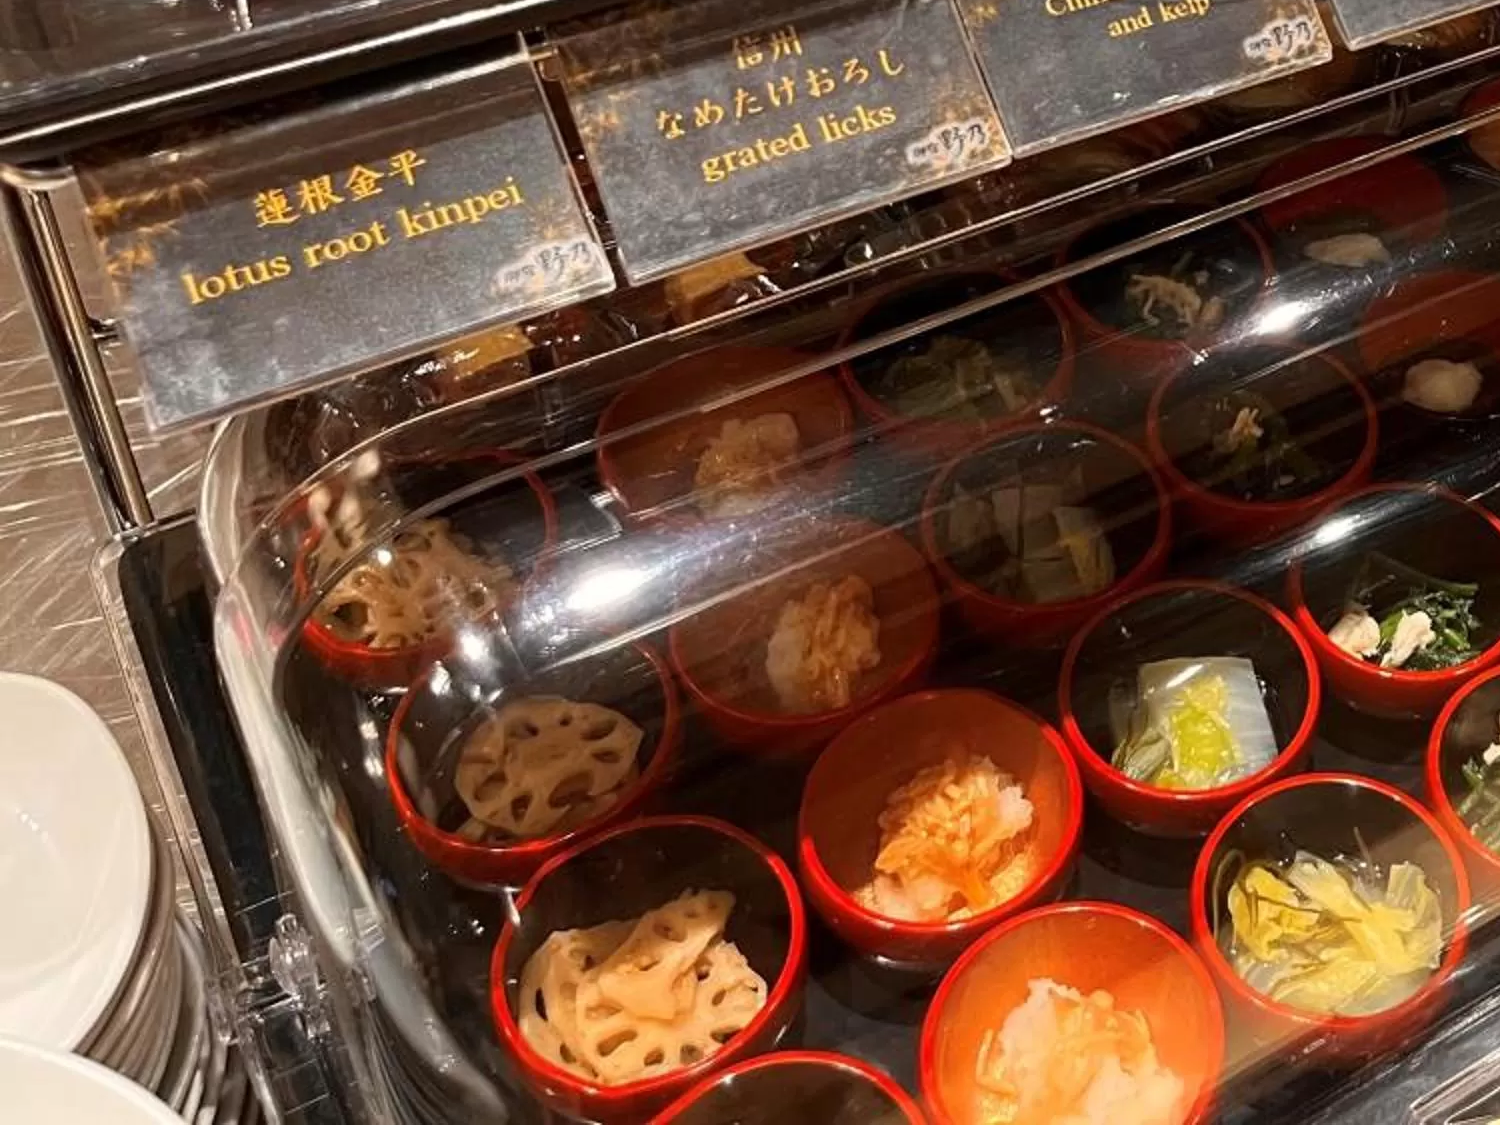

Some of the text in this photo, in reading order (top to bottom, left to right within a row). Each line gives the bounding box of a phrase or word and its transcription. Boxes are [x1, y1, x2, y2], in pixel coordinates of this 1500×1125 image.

[1107, 5, 1153, 38] and
[656, 49, 905, 140] なめたけおろし
[701, 104, 898, 183] grated licks
[252, 148, 428, 229] 蓮根金平
[181, 175, 525, 305] lotus root kinpei
